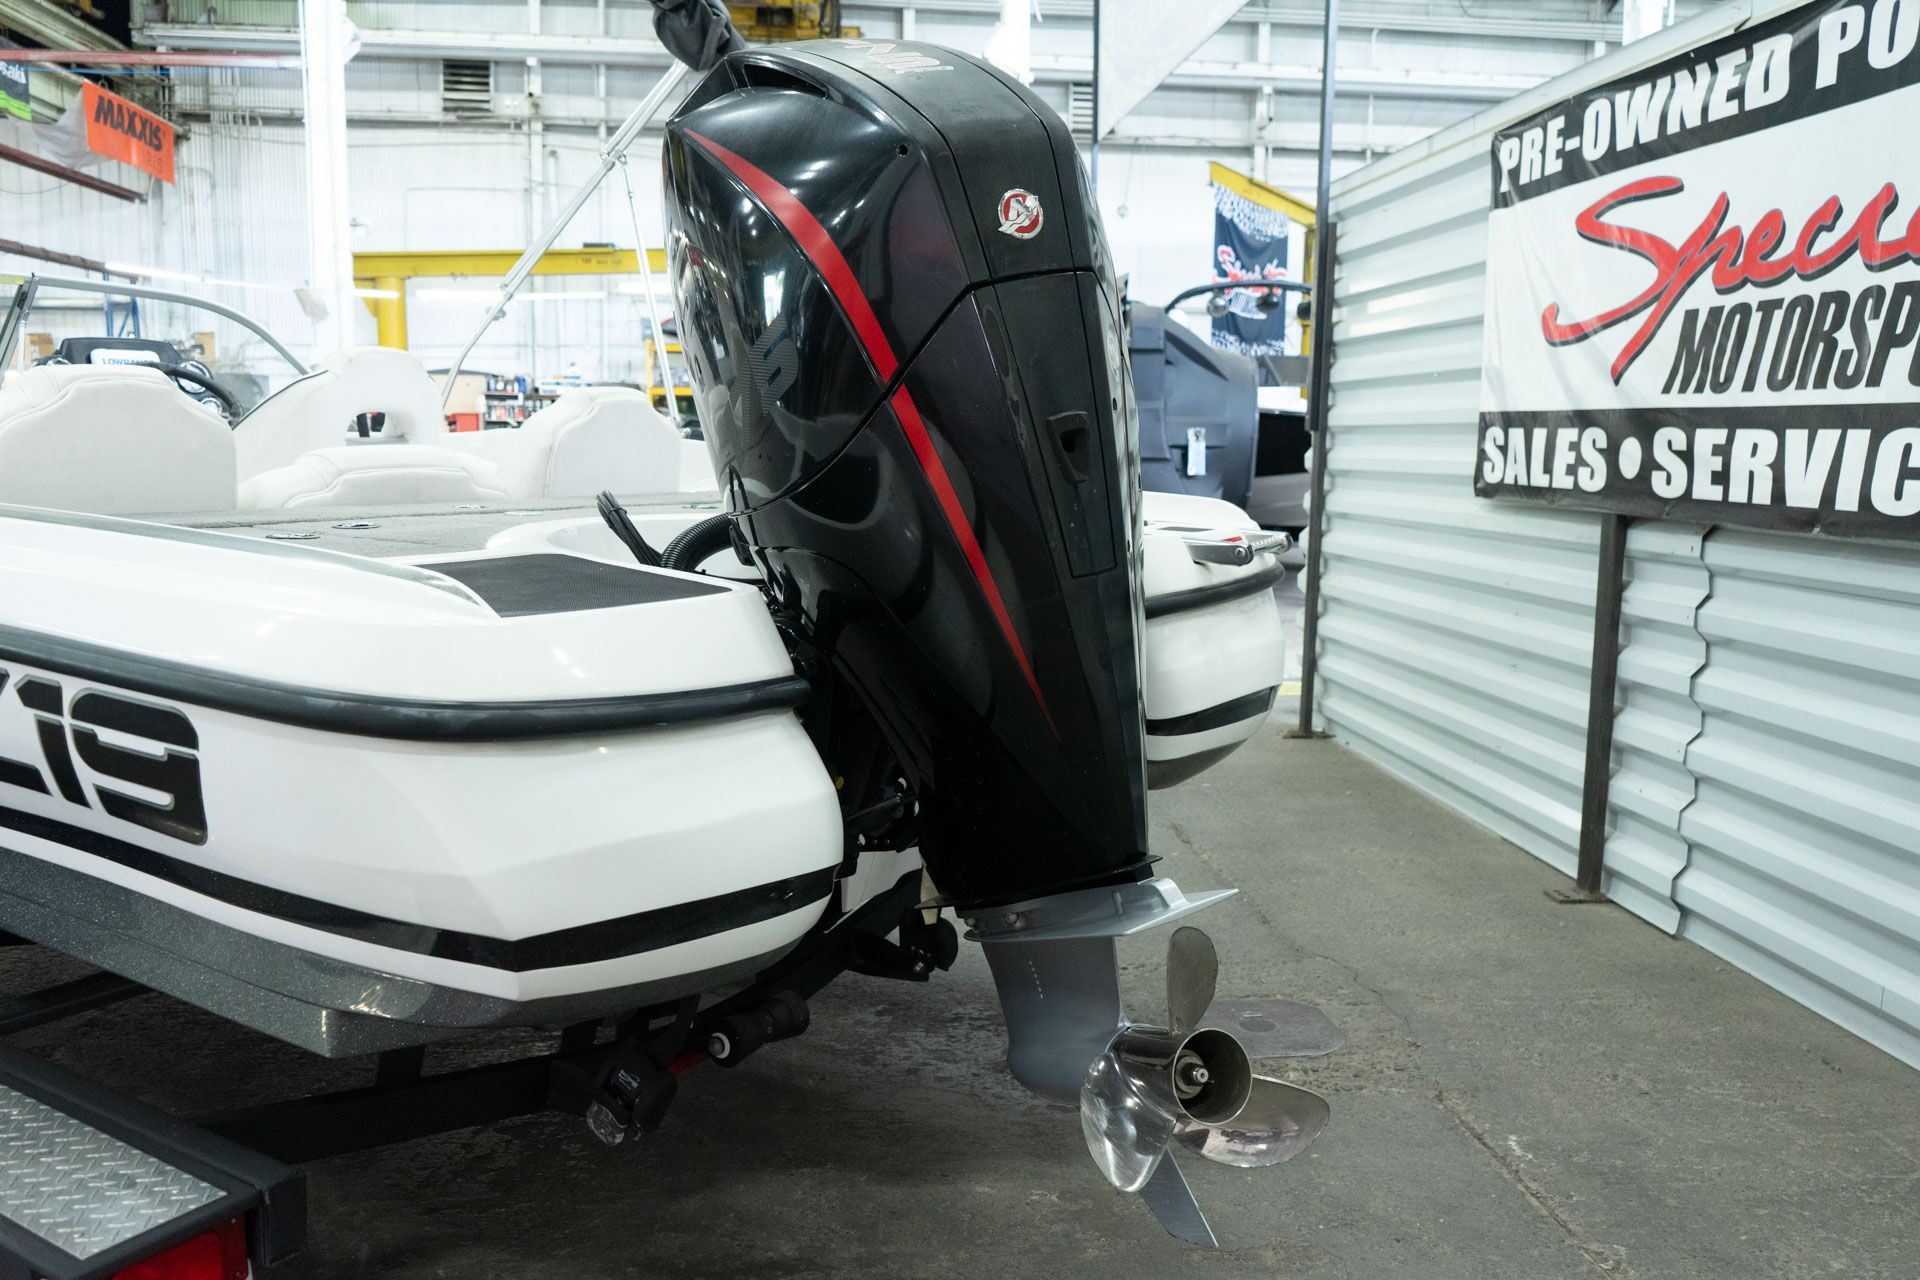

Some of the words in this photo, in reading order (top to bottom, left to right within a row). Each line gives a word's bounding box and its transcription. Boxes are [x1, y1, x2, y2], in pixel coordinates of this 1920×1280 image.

[94, 95, 162, 152] MAXXIS
[1499, 32, 1792, 193] PRE-OWNED
[1815, 0, 1920, 90] PO
[1660, 279, 1920, 394] MOTORSP
[1483, 426, 1608, 493] SALES
[1651, 427, 1920, 517] SERVIC
